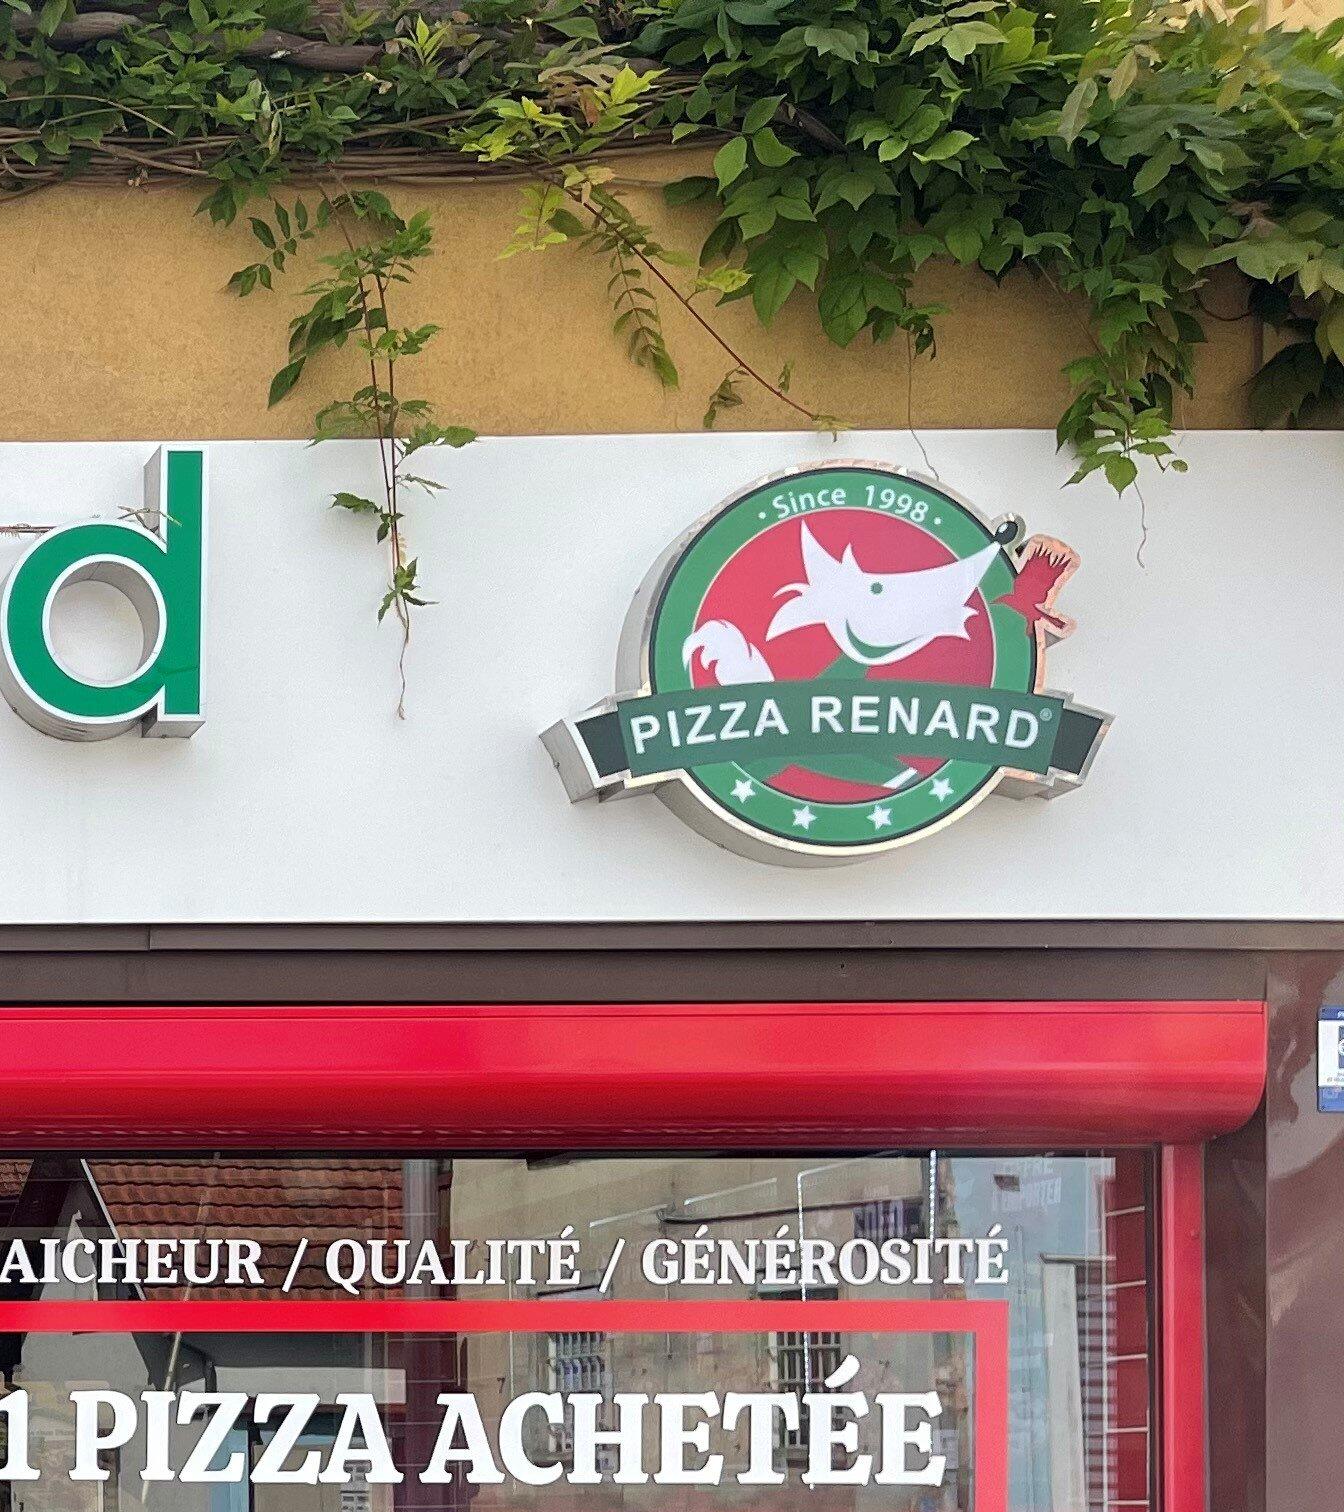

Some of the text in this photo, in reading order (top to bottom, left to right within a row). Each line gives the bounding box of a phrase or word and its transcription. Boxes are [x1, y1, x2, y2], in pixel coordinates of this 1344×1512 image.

[772, 483, 929, 521] Since 1998
[630, 696, 1040, 754] PIZZA RENARD
[325, 1232, 582, 1291] QUALITÉ
[641, 1223, 1010, 1286] GÉNÉROSITÉ
[68, 1390, 406, 1486] PIZZA
[419, 1354, 947, 1488] ACHETÉE
